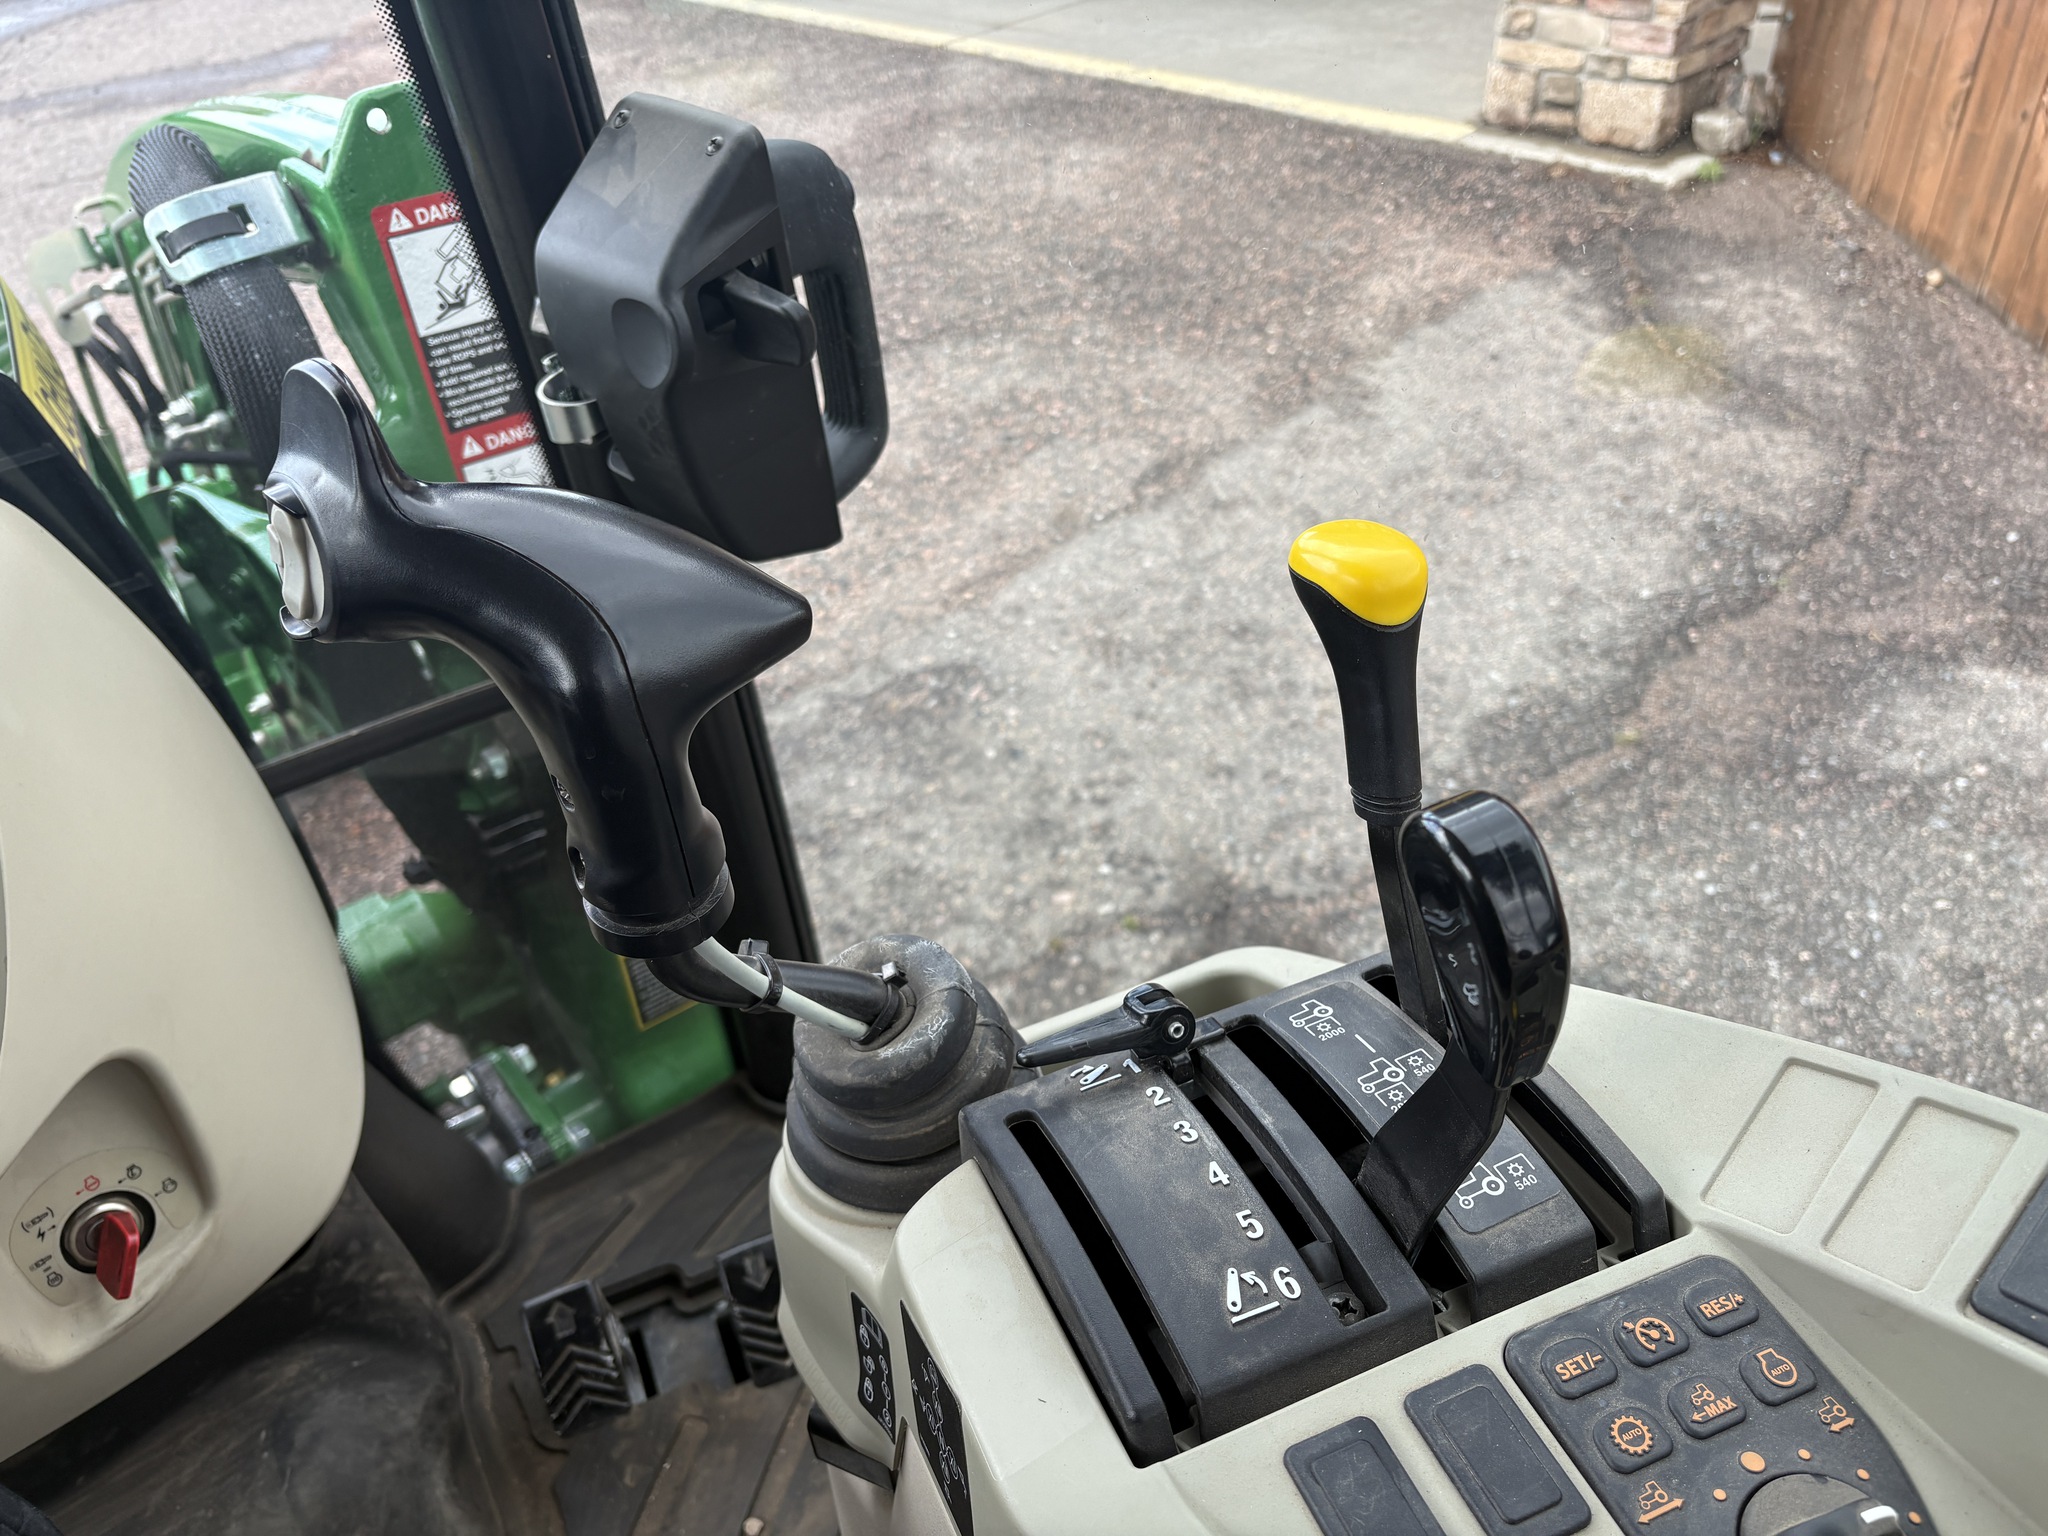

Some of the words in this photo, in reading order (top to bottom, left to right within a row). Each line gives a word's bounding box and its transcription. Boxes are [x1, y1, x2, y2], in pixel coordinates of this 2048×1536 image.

[1318, 1026, 1346, 1042] 2000
[1123, 1059, 1142, 1073] 1
[1413, 1063, 1436, 1078] 540
[1146, 1086, 1171, 1107] 2
[1173, 1120, 1199, 1143] 3
[1208, 1161, 1230, 1186] 4
[1513, 1174, 1538, 1191] 540
[1235, 1209, 1264, 1239] 5
[1273, 1266, 1301, 1299] 6
[1699, 1293, 1744, 1319] RES/+
[1555, 1352, 1604, 1381] SET/-
[1771, 1363, 1790, 1377] AUTO
[1704, 1396, 1738, 1418] MAX
[1621, 1427, 1643, 1442] AUTO
